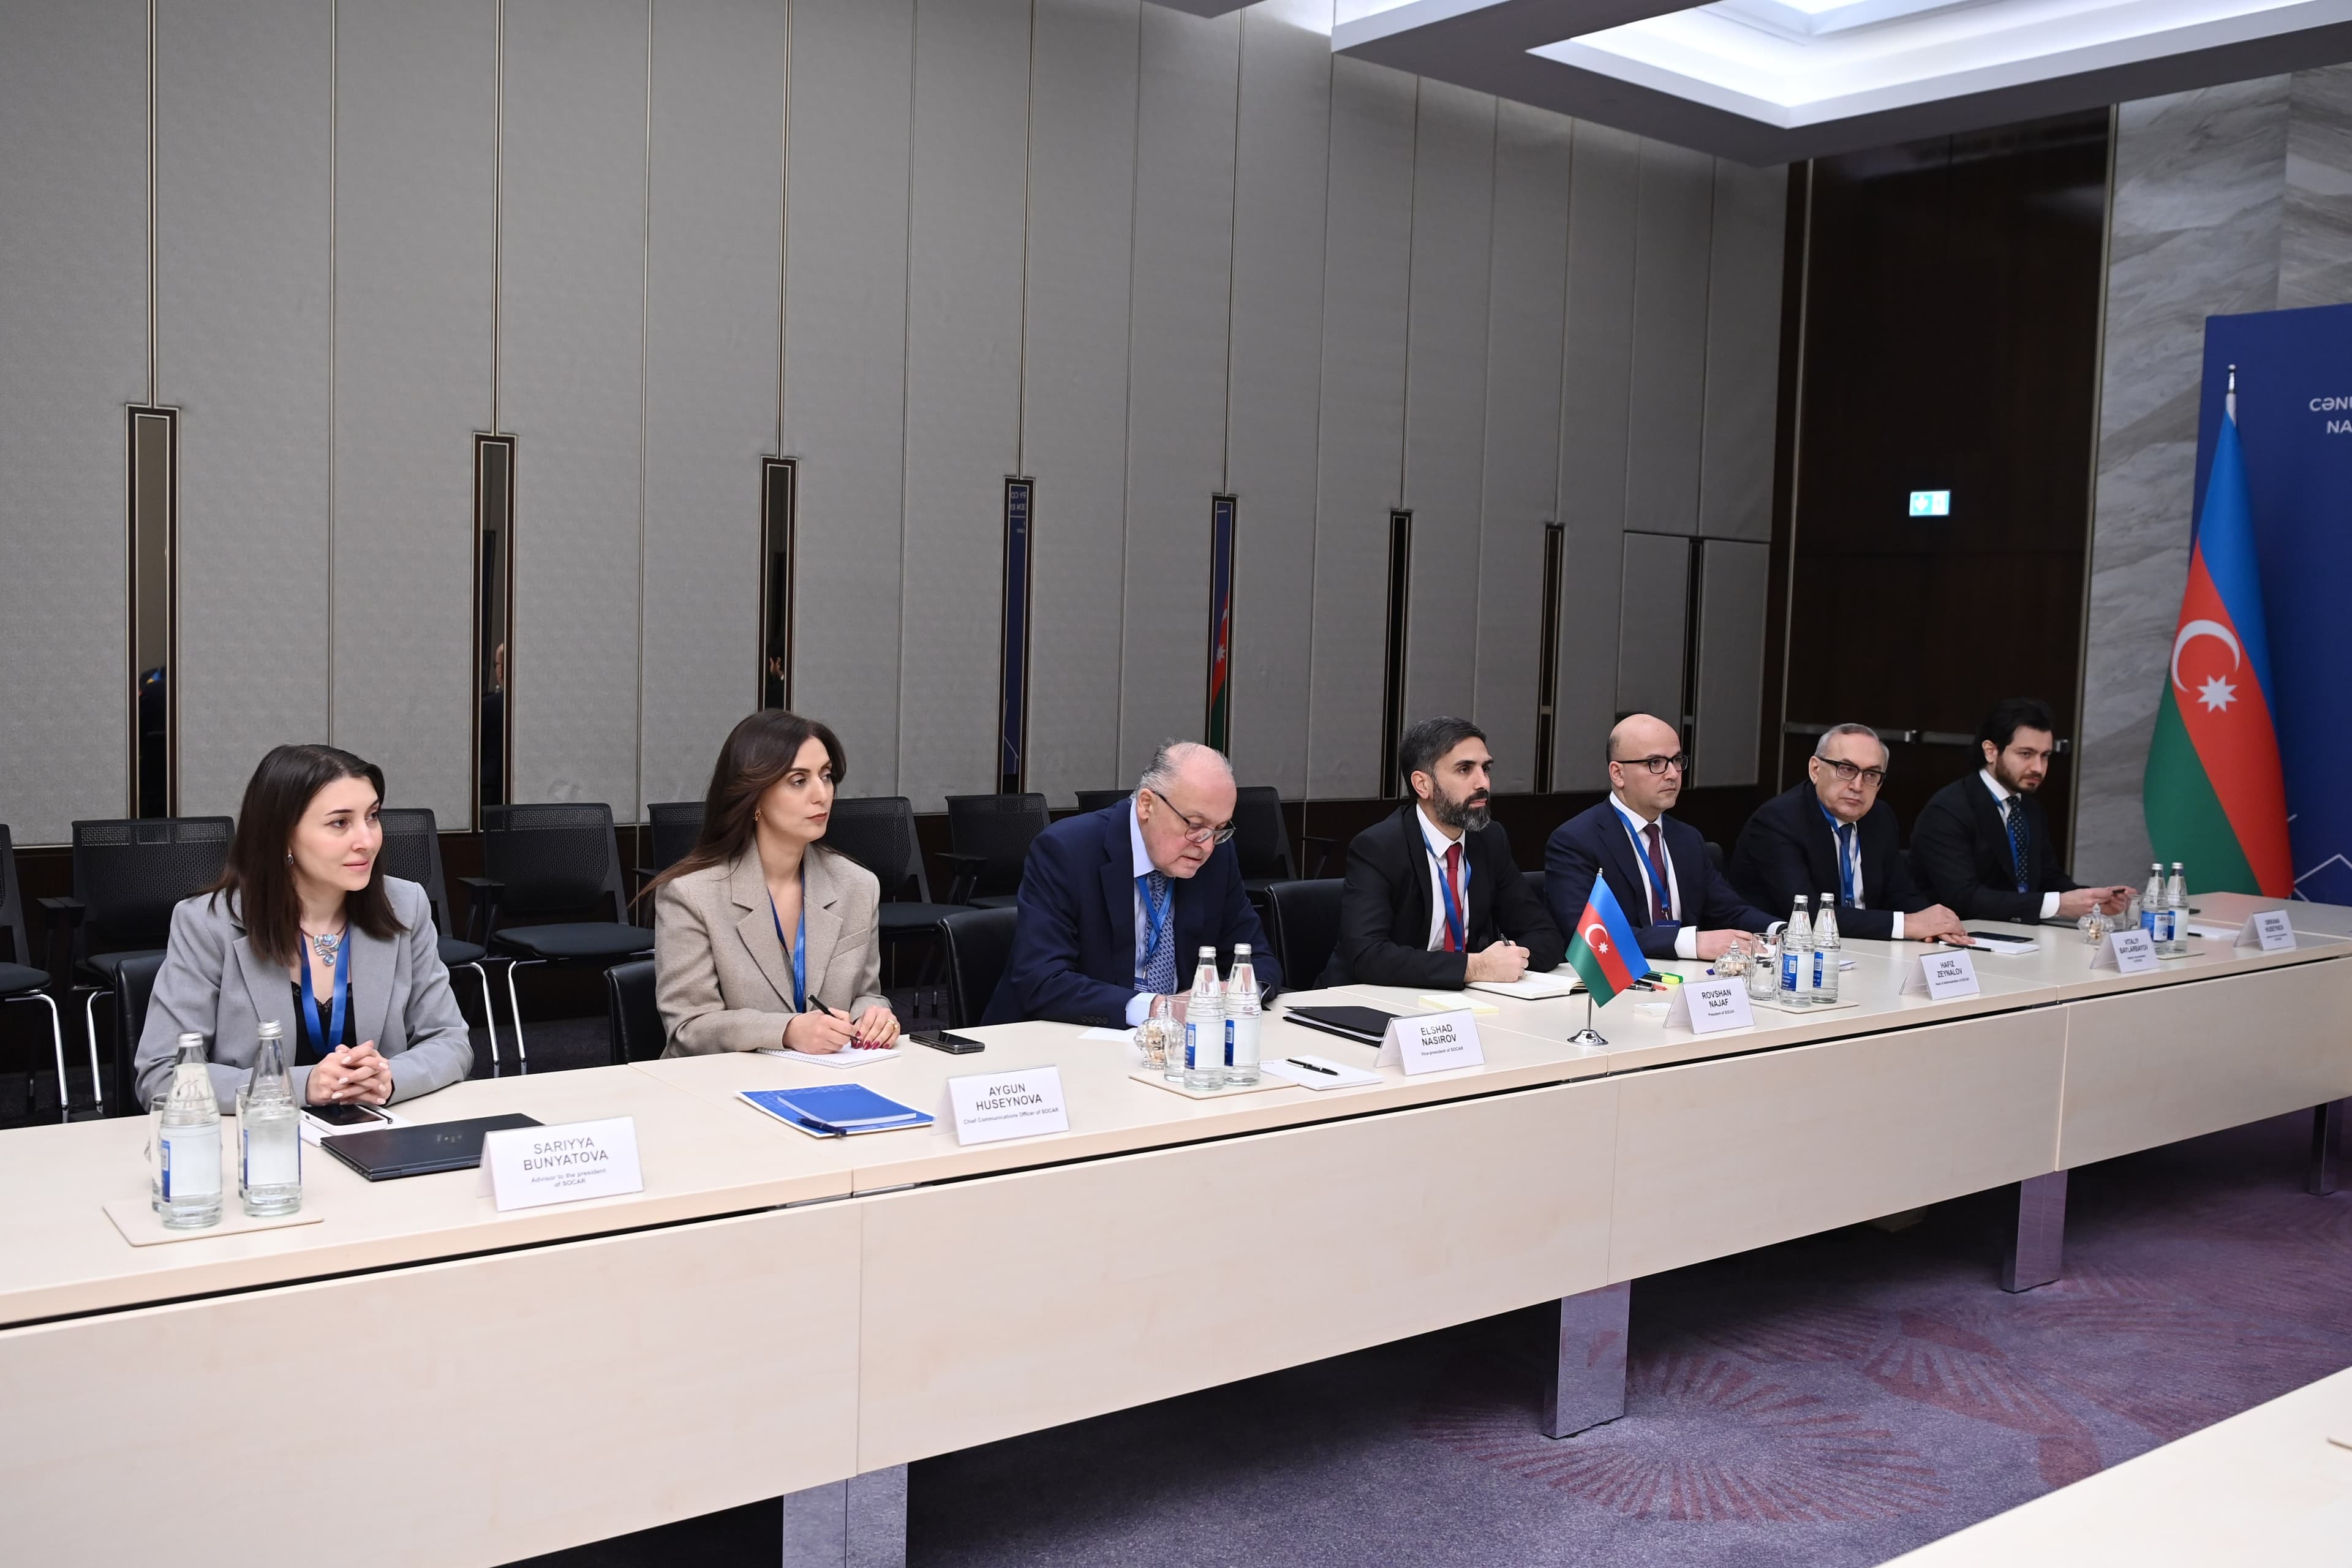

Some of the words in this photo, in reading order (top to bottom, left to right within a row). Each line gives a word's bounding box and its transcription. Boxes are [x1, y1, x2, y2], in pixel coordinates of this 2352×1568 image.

[1937, 968, 1962, 978] ZEYNALOV
[1702, 989, 1732, 1000] ROVSHAN
[1709, 998, 1728, 1008] NAJAF
[1420, 1024, 1453, 1036] ELSHAD
[1422, 1033, 1457, 1046] NASIROV
[989, 1083, 1026, 1096] AYGUN
[976, 1093, 1042, 1111] HUSEYNOVA
[978, 1113, 1018, 1122] Communications
[533, 1137, 594, 1155] SARIYYA
[524, 1150, 608, 1170] BUNYATOVA
[578, 1168, 606, 1177] president
